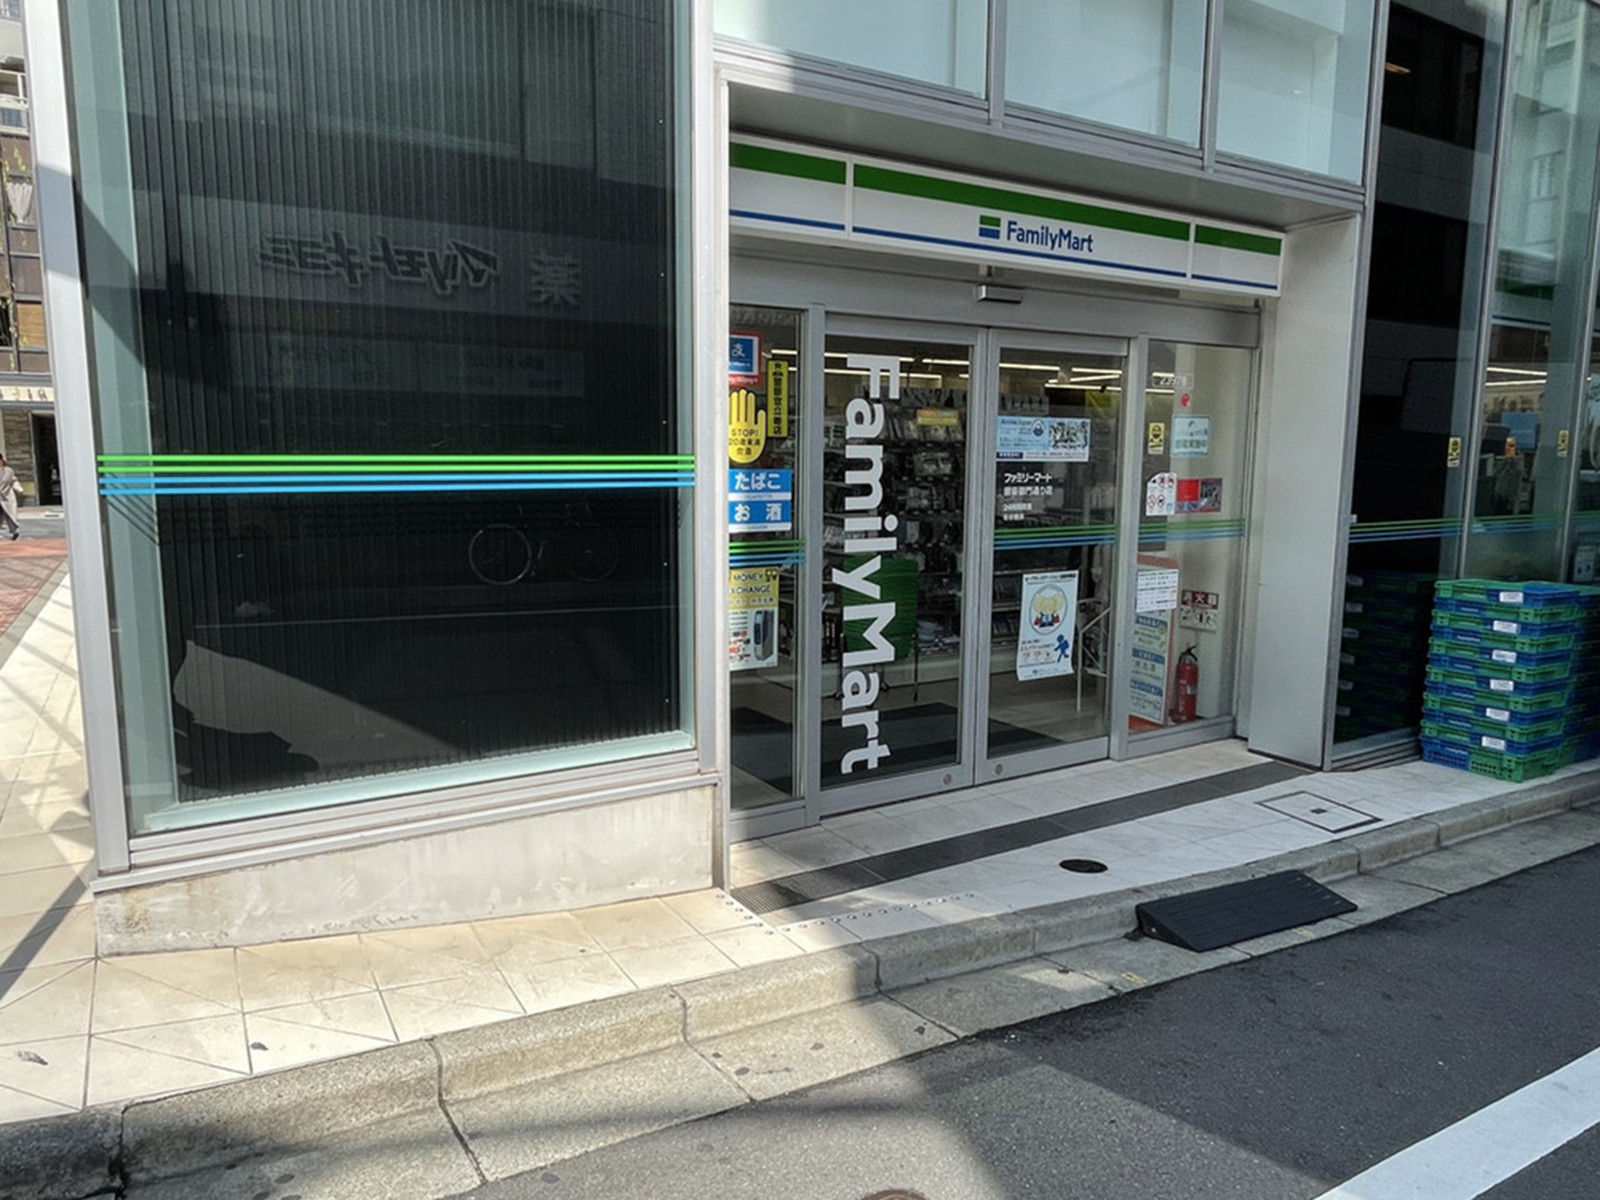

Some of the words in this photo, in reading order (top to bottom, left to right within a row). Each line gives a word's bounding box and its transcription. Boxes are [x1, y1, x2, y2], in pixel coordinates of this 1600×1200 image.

[1007, 220, 1093, 252] FamilyMart
[735, 472, 781, 491] たばこ
[1004, 472, 1053, 483] ファミリーマート
[832, 353, 900, 774] FamilyMart
